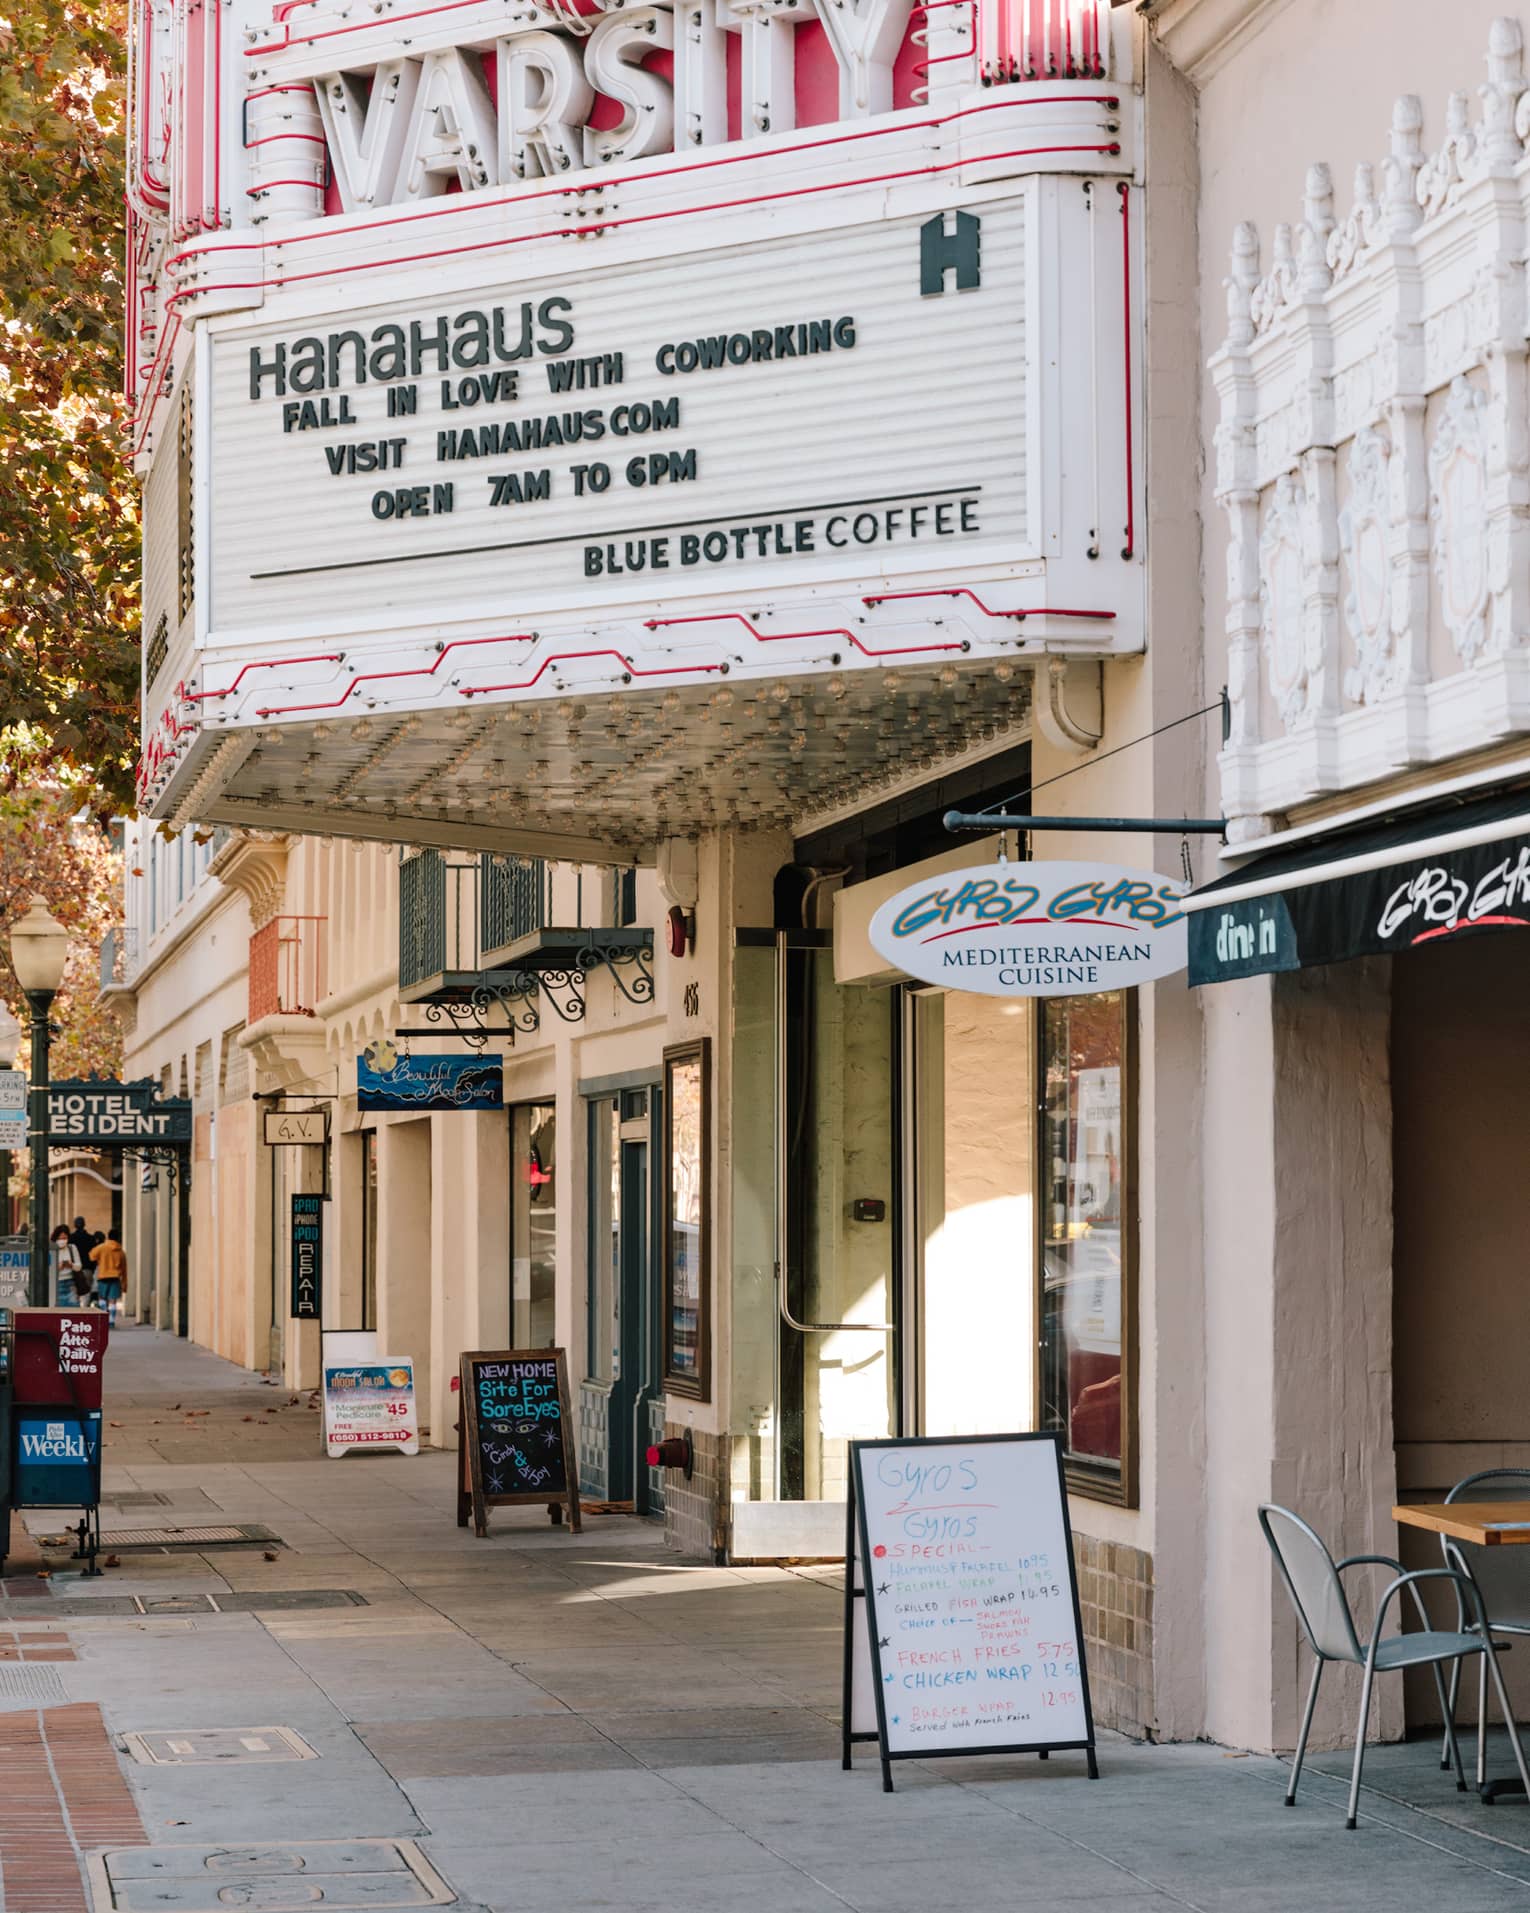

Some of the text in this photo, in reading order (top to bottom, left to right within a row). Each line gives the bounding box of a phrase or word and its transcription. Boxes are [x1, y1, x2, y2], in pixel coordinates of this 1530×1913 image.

[313, 0, 916, 216] VARSITY
[283, 316, 856, 433] FALL IN LOVE WITH COWORKING
[325, 437, 407, 475] VISIT
[371, 448, 697, 520] OPEN 7AM TO 6PM
[583, 498, 981, 577] BLUE BOTTLE COFFEE
[891, 877, 1040, 938] GYROS
[1259, 907, 1277, 956] in
[942, 943, 1152, 967] MEDITERRANEAN
[998, 965, 1099, 986] CUISINE
[48, 1095, 141, 1115] HOTEL
[298, 1243, 315, 1313] REPAIR
[60, 1318, 93, 1333] Palo
[59, 1346, 96, 1363] Daily
[58, 1360, 97, 1374] News
[479, 1362, 556, 1379] NEW HOME
[479, 1379, 555, 1398] Site For
[21, 1434, 96, 1462] Weekly
[894, 1601, 938, 1614] GRILLED
[983, 1592, 1015, 1607] WRAP
[896, 1647, 962, 1667] FRENCH
[974, 1643, 1021, 1661] FRIES
[903, 1669, 977, 1689] CHICKEN
[986, 1663, 1032, 1681] WRAP
[911, 1705, 969, 1722] BURGER
